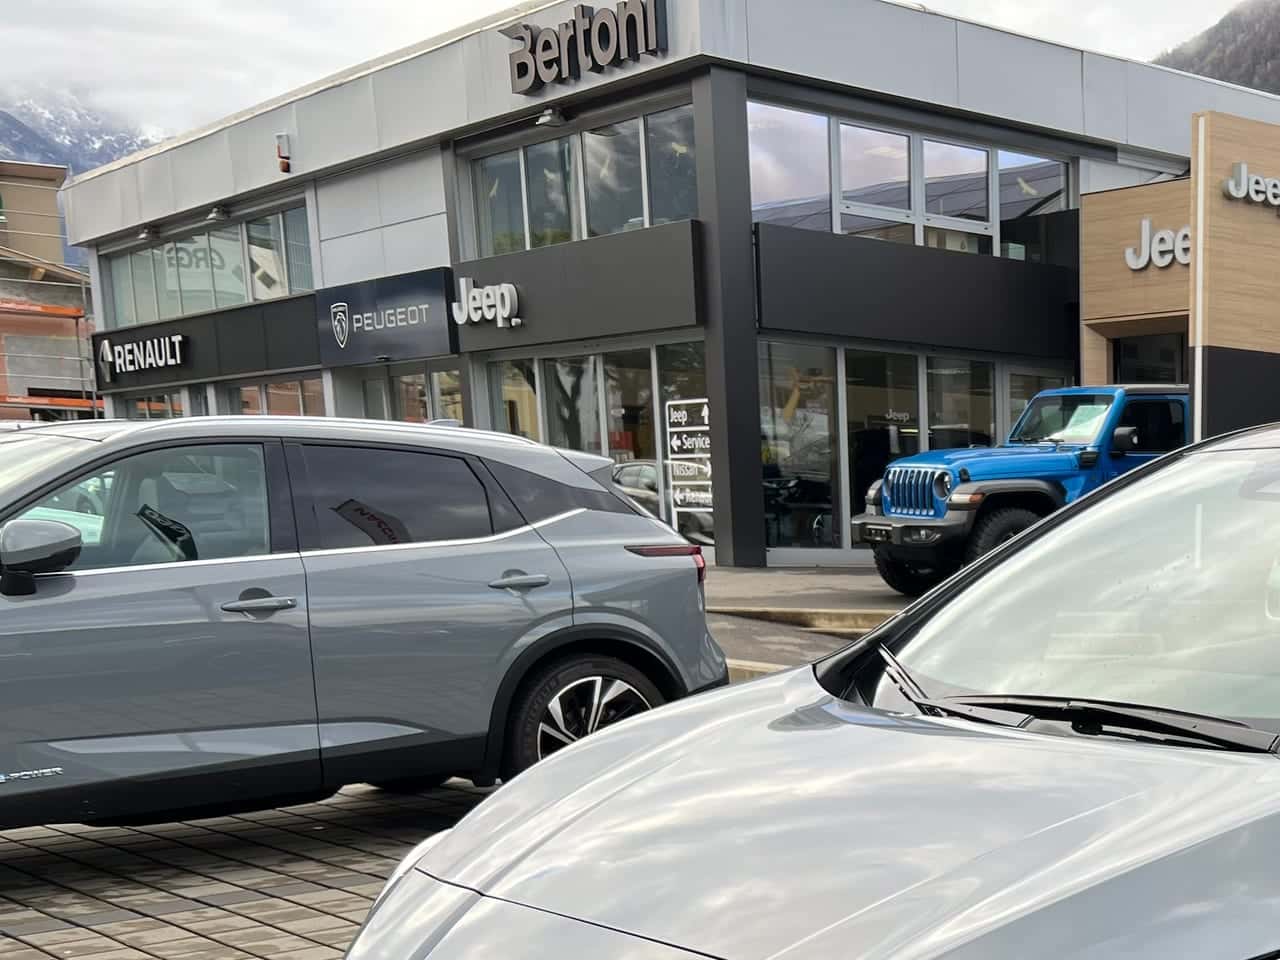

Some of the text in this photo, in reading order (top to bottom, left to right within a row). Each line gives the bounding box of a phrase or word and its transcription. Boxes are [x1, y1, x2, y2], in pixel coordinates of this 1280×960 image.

[498, 0, 667, 94] Bertoni
[1124, 217, 1191, 271] Jee
[352, 303, 430, 333] PEUGEOT
[452, 277, 519, 328] Jeep
[113, 334, 184, 374] RENAULT
[670, 407, 688, 425] Jeep
[884, 408, 910, 423] Jeep
[682, 433, 711, 450] Service
